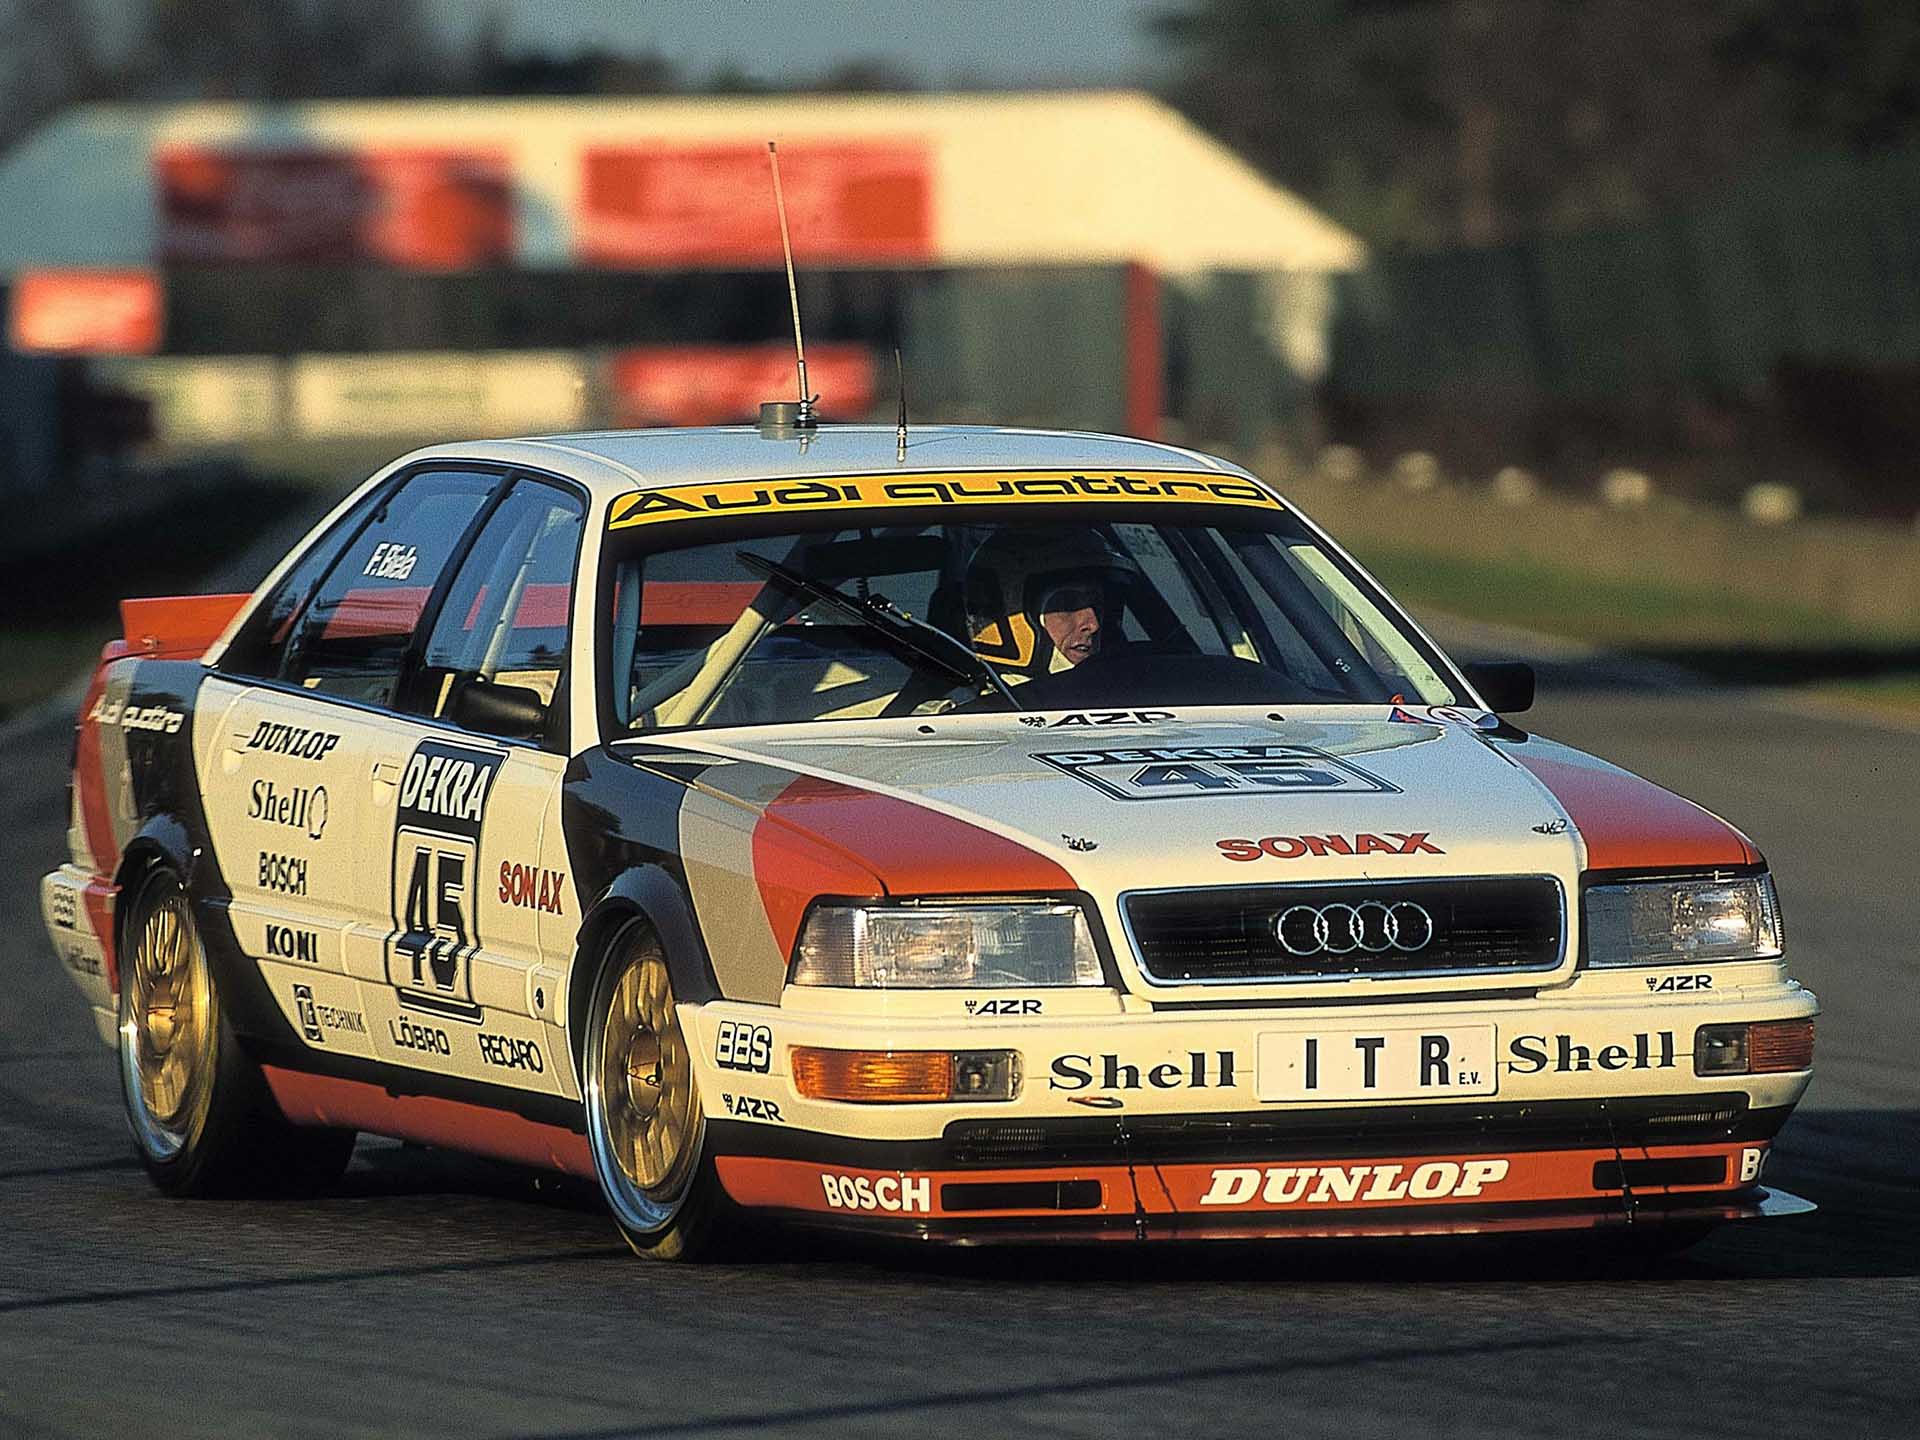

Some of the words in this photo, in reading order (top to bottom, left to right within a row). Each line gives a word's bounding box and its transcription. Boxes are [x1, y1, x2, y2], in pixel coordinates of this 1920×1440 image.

[611, 482, 862, 523] Audi
[883, 475, 1269, 502] quattro
[247, 721, 341, 760] DUNLOP
[1046, 746, 1320, 765] DEKRA
[400, 753, 492, 822] DEKRA
[1128, 761, 1347, 790] 45
[247, 779, 308, 828] Shell
[1215, 833, 1447, 862] SONAX
[258, 851, 307, 896] BOSCH
[499, 860, 565, 915] SONAX
[395, 846, 468, 991] 45
[266, 924, 317, 963] KONI
[1656, 974, 1713, 991] AZR
[316, 1005, 367, 1034] TECHNIK
[975, 1000, 1043, 1015] AZR
[388, 1016, 451, 1055] LÖBRO
[478, 1033, 543, 1073] RECARO
[716, 1021, 772, 1073] BBS
[1508, 1031, 1677, 1074] Shell
[1050, 1050, 1237, 1090] Shell
[1459, 1072, 1482, 1085] E.V.
[734, 1096, 785, 1122] AZR
[1200, 1160, 1510, 1205] DUNLOP
[1740, 1148, 1766, 1182] B
[821, 1173, 931, 1212] BOSCH
